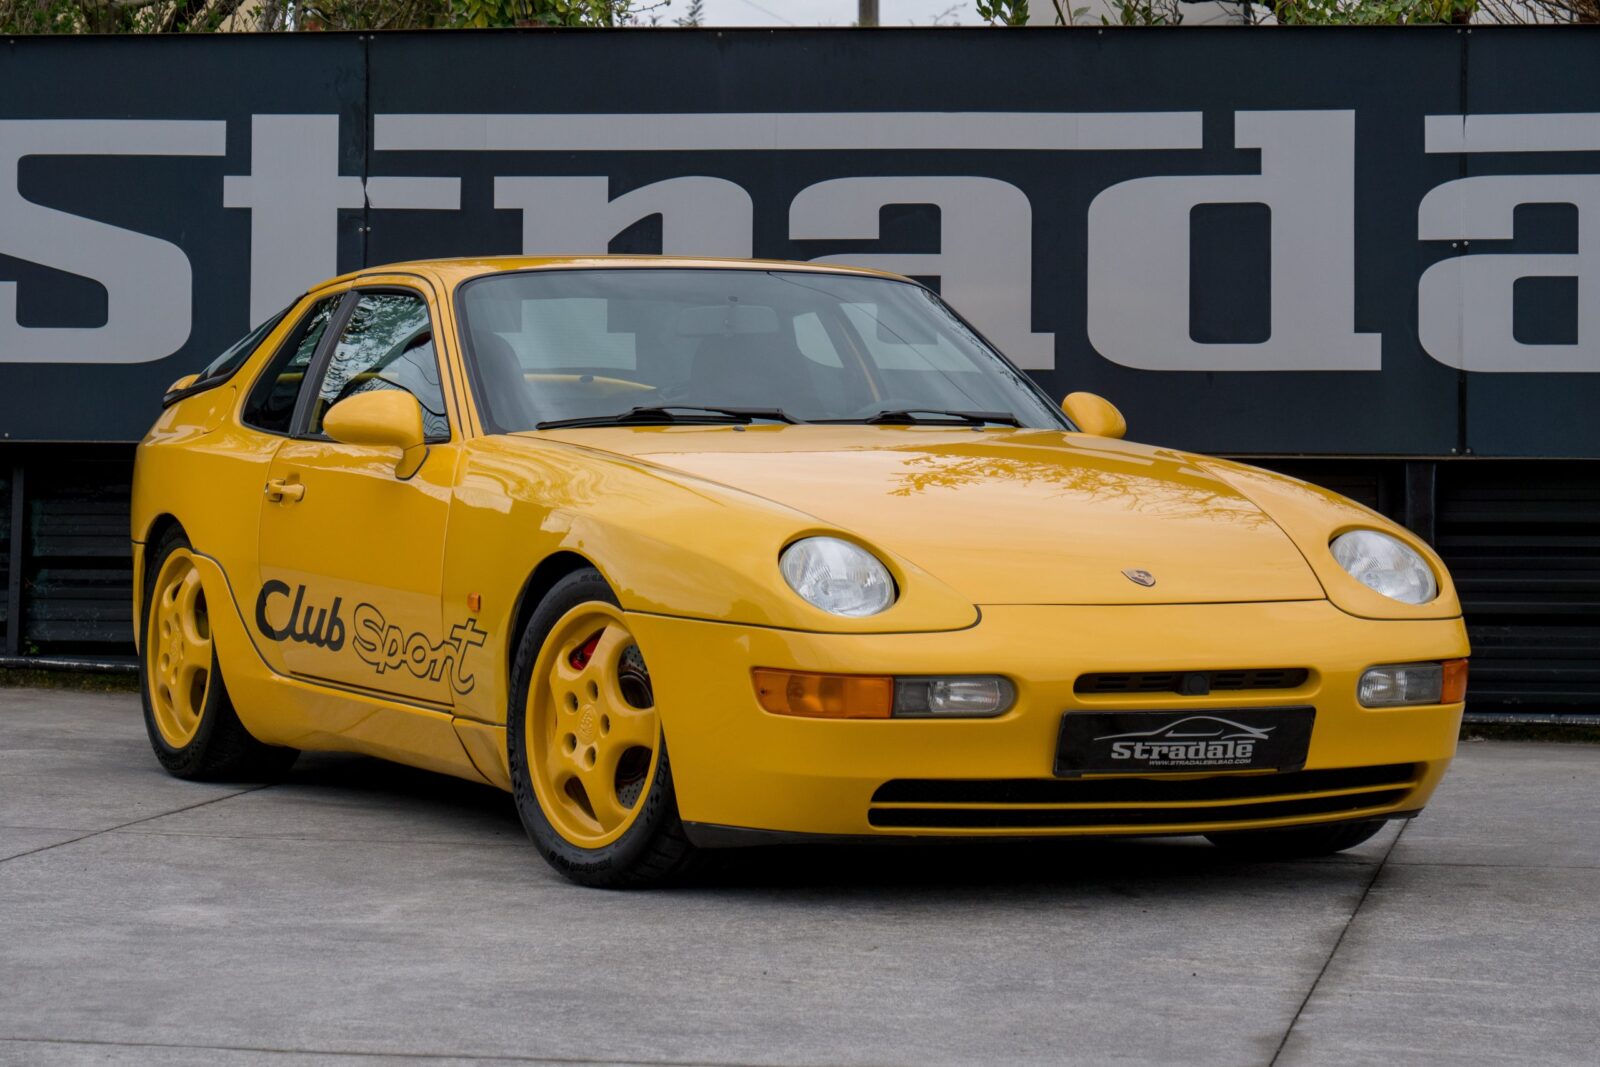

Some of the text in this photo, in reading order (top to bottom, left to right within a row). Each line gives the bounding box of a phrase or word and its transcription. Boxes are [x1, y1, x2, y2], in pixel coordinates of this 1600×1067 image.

[255, 579, 488, 695] Club Sport
[1111, 740, 1256, 759] Stradale
